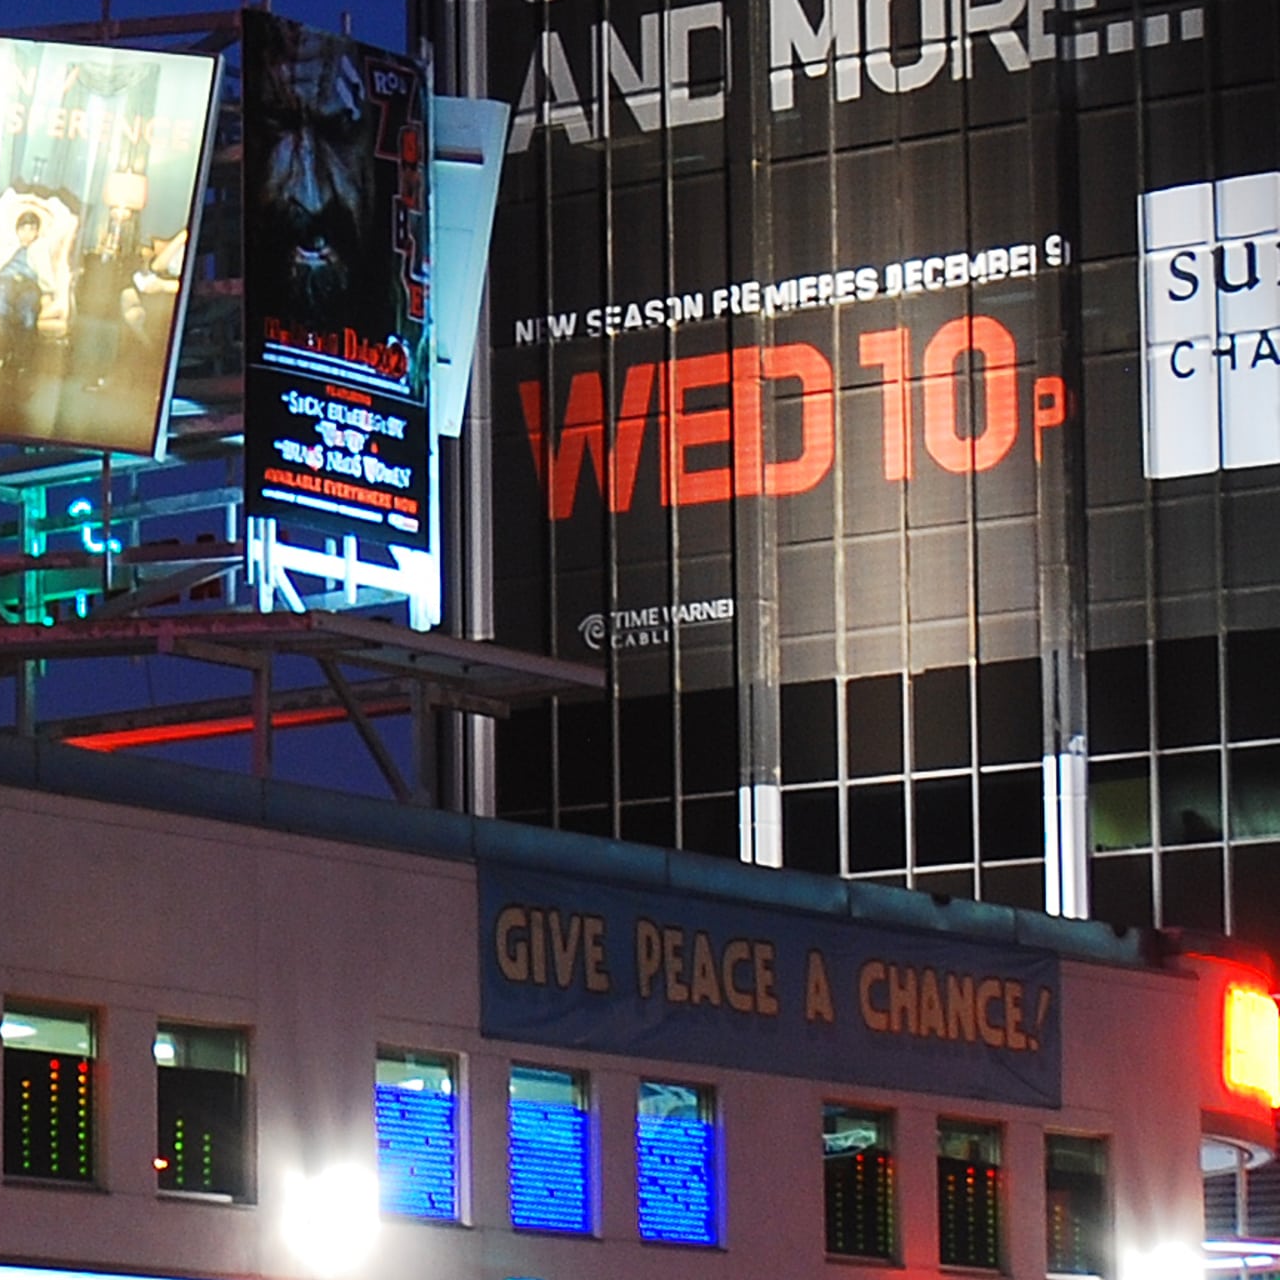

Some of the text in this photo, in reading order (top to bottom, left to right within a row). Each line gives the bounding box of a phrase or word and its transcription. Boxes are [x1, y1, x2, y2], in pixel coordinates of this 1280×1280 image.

[507, 0, 731, 155] AND
[518, 340, 835, 520] WED
[609, 606, 660, 630] TIME
[495, 904, 1052, 1053] GIVE PEACE A CHANCE!
